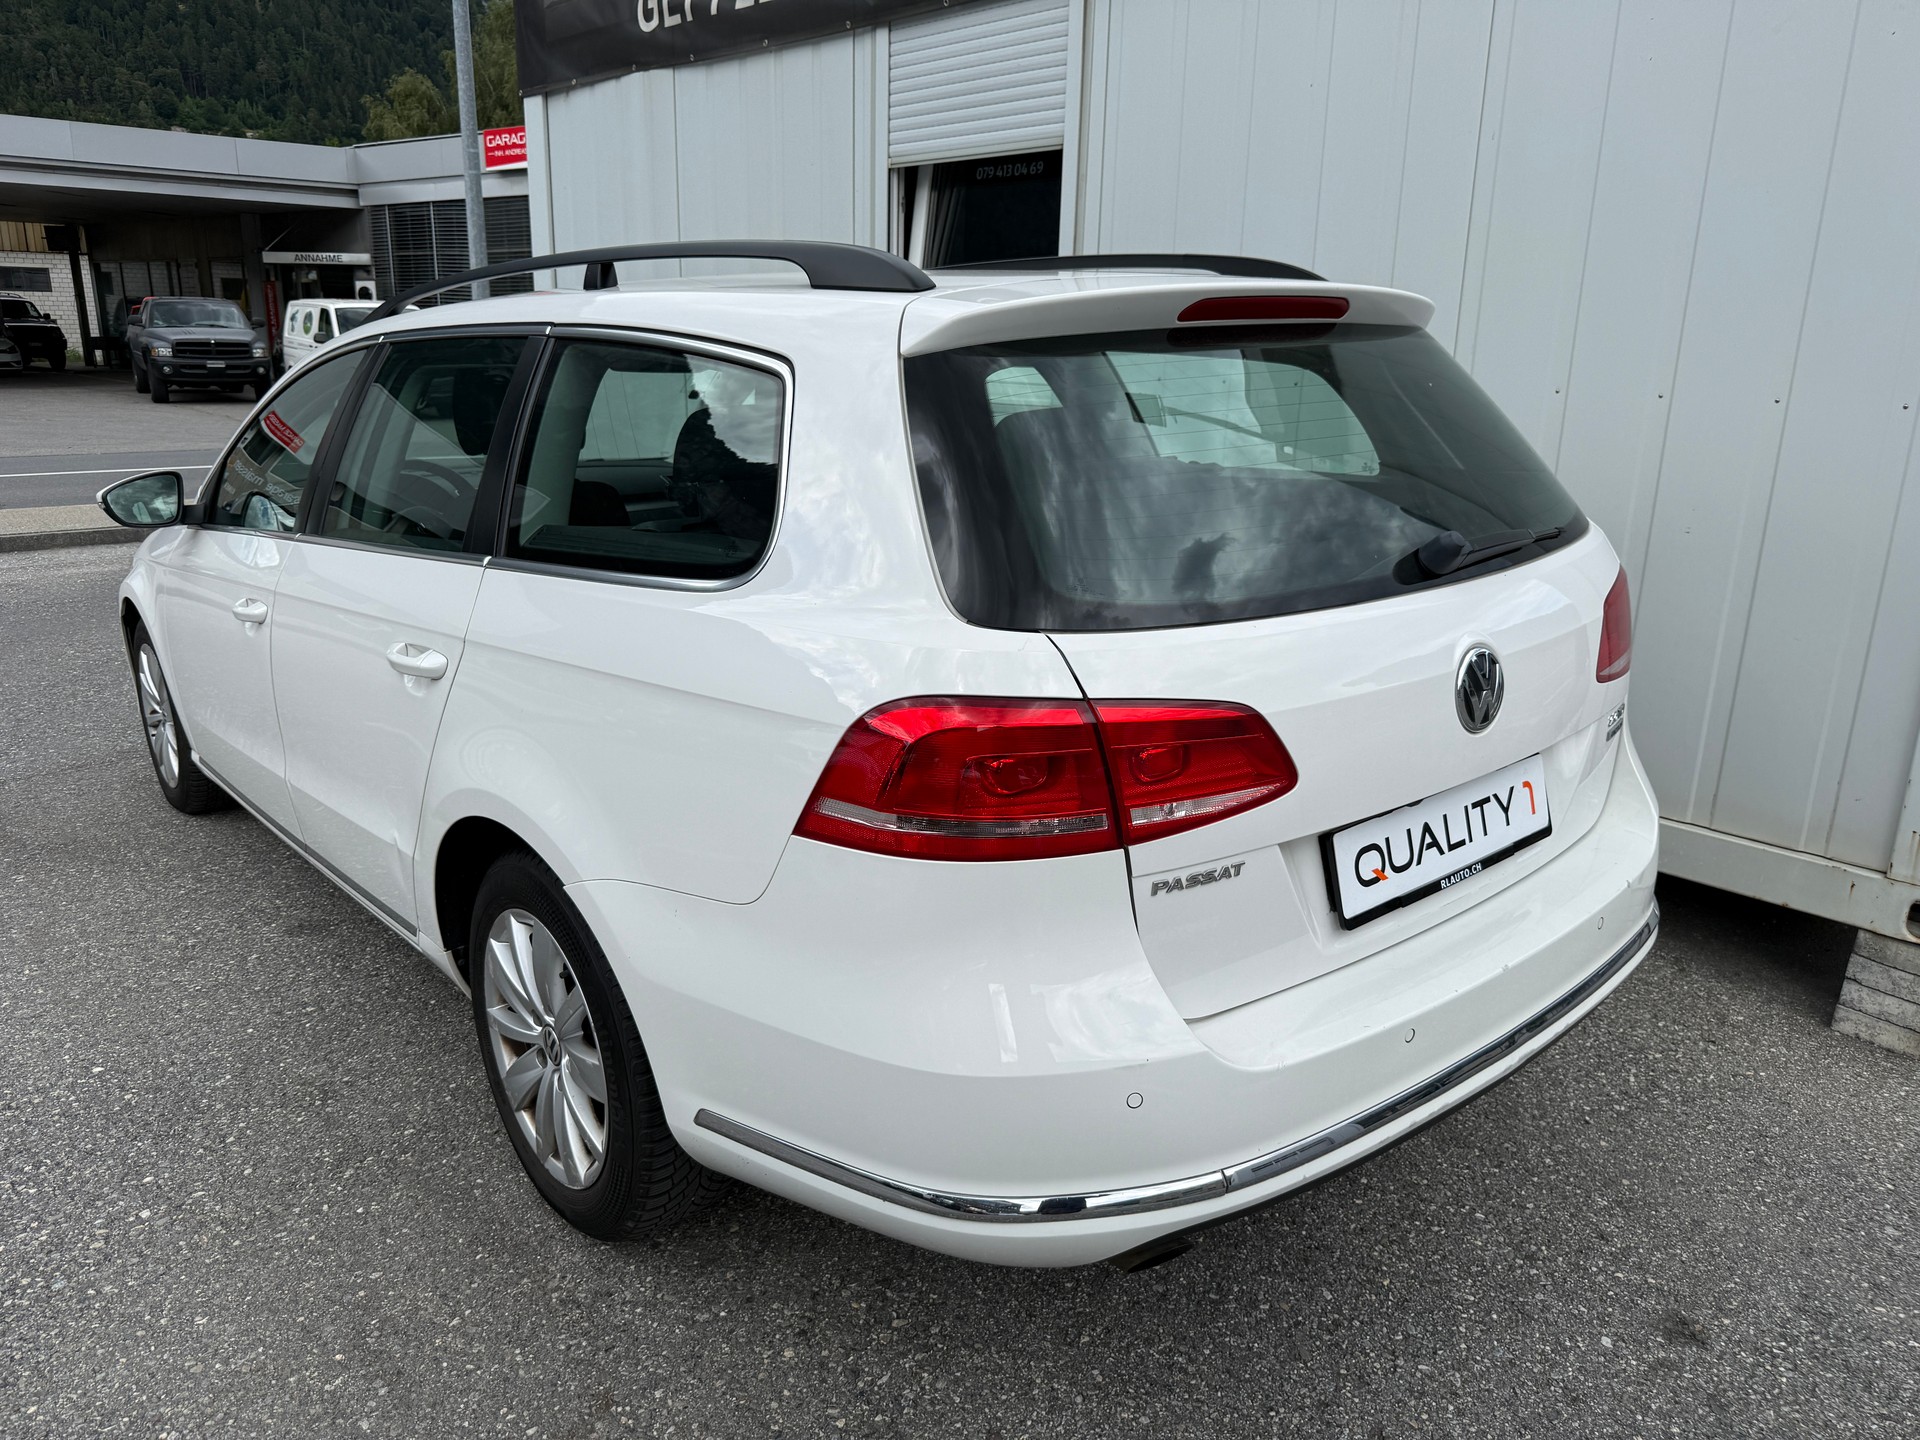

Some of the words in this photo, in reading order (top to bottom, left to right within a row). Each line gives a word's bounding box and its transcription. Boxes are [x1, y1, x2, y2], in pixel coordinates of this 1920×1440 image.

[976, 166, 994, 180] 079
[996, 164, 1012, 178] 413
[1014, 163, 1027, 176] 04
[1029, 161, 1044, 174] 69
[294, 254, 343, 263] ANNAHME
[1354, 785, 1515, 888] QUALITY
[1522, 780, 1536, 815] 1
[1150, 860, 1246, 897] PASSAT
[1440, 862, 1482, 889] RLAUTO.CH
